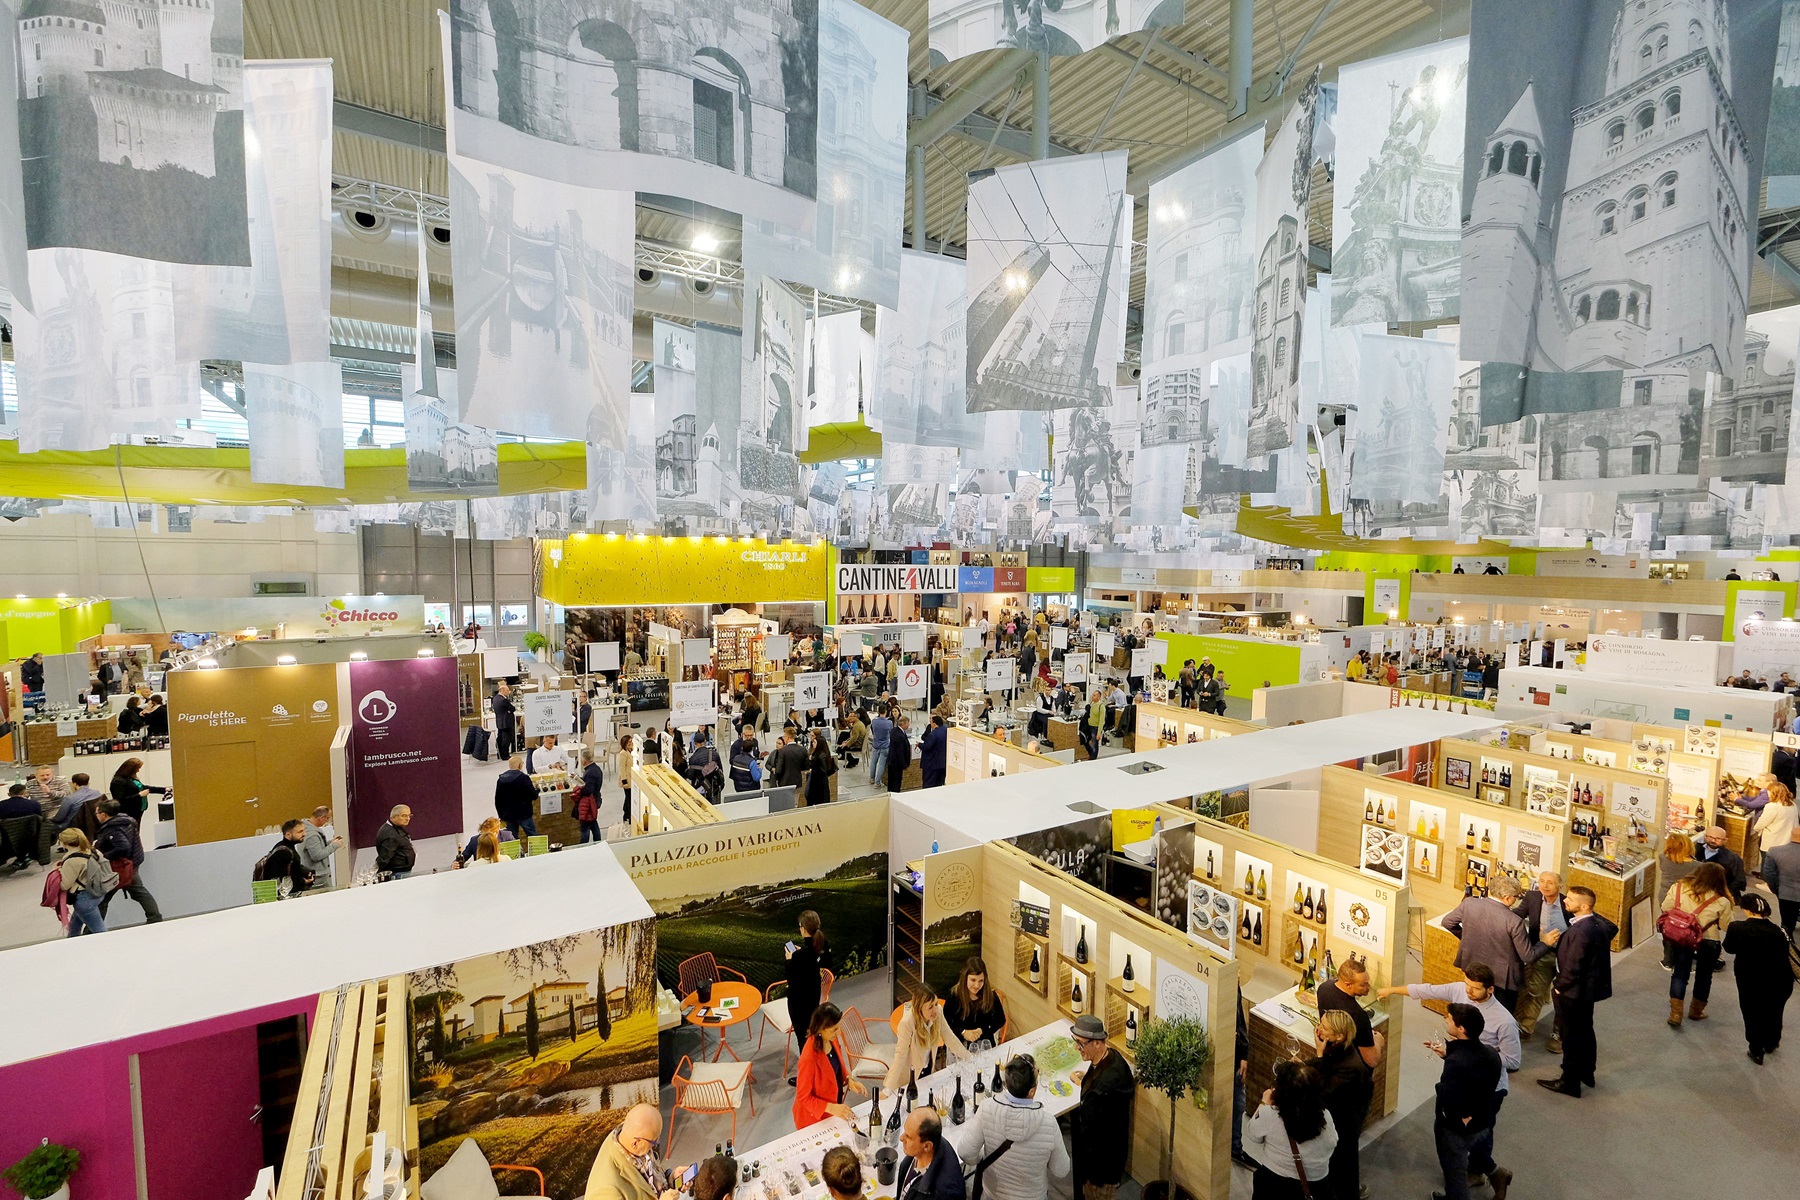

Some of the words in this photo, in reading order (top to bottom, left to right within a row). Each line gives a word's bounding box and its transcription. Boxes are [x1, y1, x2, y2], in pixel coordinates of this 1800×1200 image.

[741, 550, 807, 562] CHIARLI
[338, 608, 399, 622] Chicco
[373, 704, 383, 716] L
[178, 710, 235, 723] Pignoletto
[210, 719, 218, 727] IS
[220, 716, 247, 726] HERE
[1787, 736, 1797, 746] D
[364, 749, 422, 762] lambrusco.net
[364, 761, 387, 769] Explore
[387, 758, 420, 766] Lambrusco
[1647, 779, 1659, 787] D8
[1544, 824, 1556, 833] D7
[630, 842, 709, 868] PALAZZO
[714, 840, 732, 852] DI
[738, 822, 823, 848] VARIGNANA
[1519, 843, 1540, 853] Randi
[631, 870, 644, 879] LA
[646, 863, 684, 877] STORIA
[686, 852, 740, 869] RACCOGLIE
[747, 848, 769, 857] SUOI
[770, 841, 801, 853] FRUTTI
[1375, 889, 1388, 901] D5
[1340, 922, 1378, 943] SECULA
[1197, 962, 1209, 978] D4
